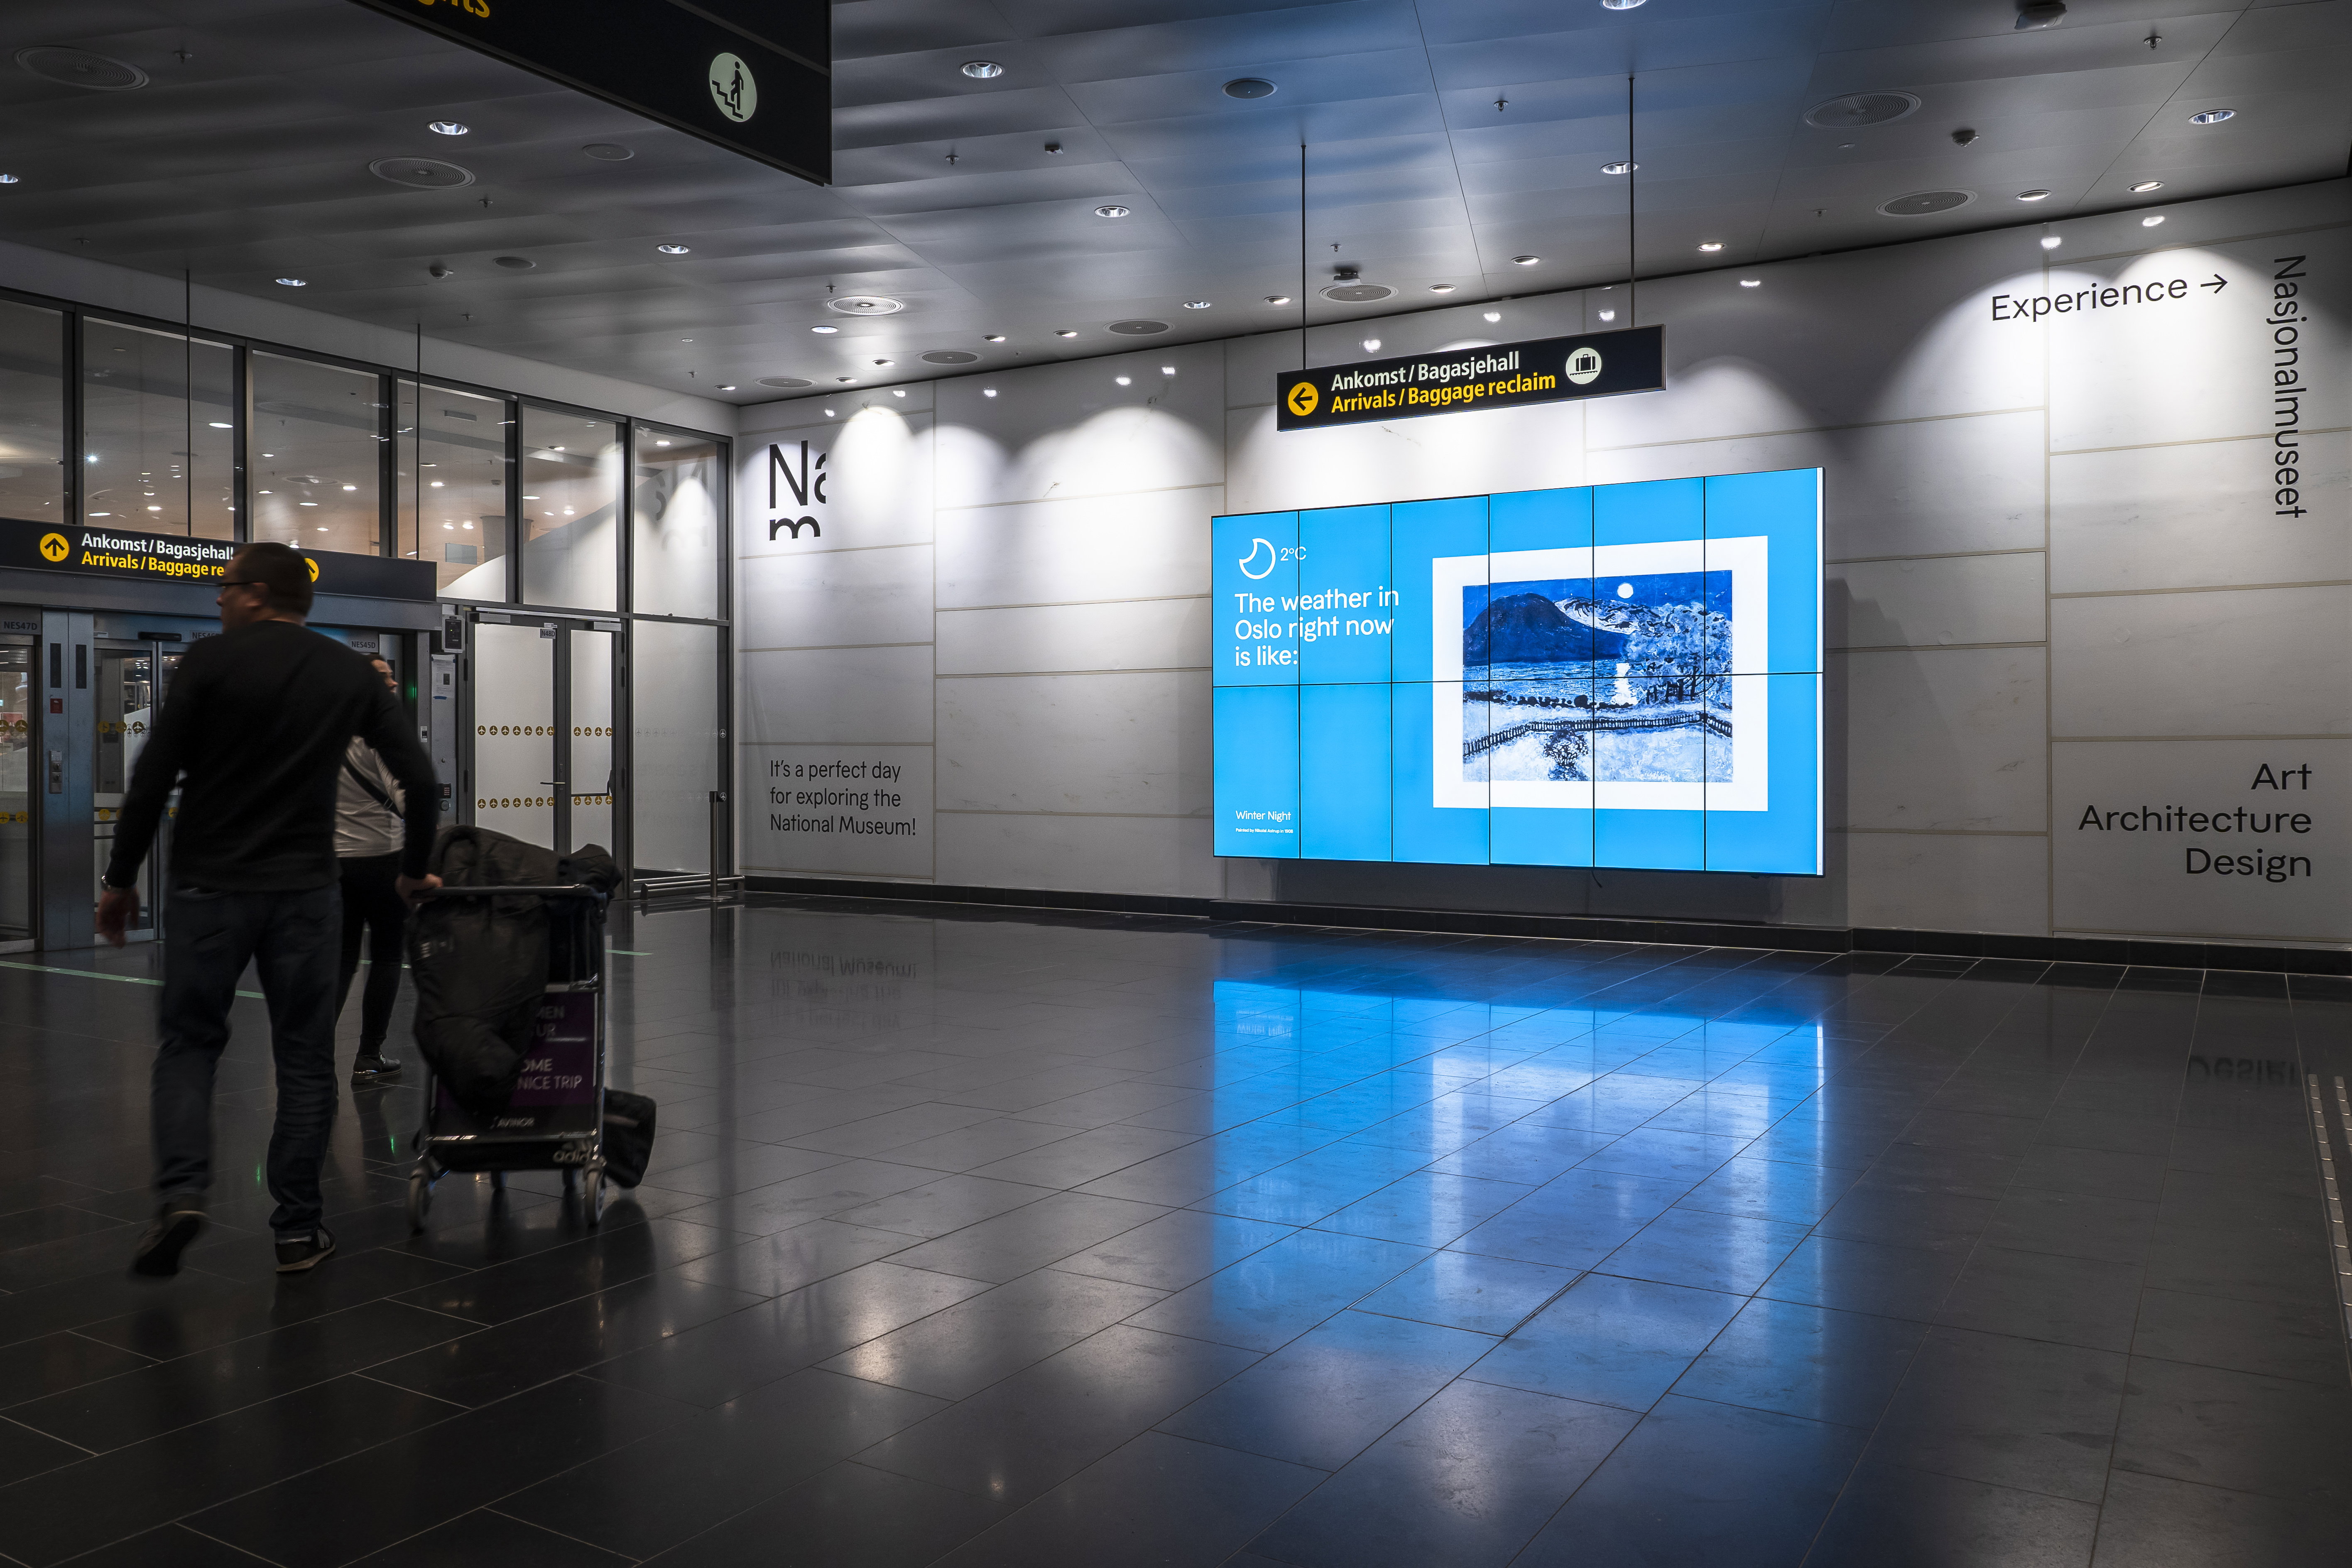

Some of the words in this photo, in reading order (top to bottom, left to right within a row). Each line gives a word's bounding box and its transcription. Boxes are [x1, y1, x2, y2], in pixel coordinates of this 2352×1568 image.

[1992, 278, 2188, 322] Experience
[1331, 368, 1406, 391] Ankomst
[1419, 351, 1519, 382] Bagasjehall
[1331, 390, 1395, 413] Arrivals
[1409, 382, 1484, 406] Baggage
[1489, 372, 1555, 395] reclaim
[2266, 255, 2308, 518] Nasjonalmuseet
[81, 533, 147, 552] Ankomst
[81, 551, 139, 569] Arrivals
[149, 557, 208, 578] Baggage
[1235, 593, 1275, 613] The
[1281, 588, 1372, 611] weather
[1379, 586, 1399, 607] in
[4, 621, 37, 630] NES47D
[1235, 619, 1282, 640] Oslo
[1289, 615, 1339, 642] right
[1346, 618, 1394, 636] now
[351, 641, 376, 649] NES45D
[1235, 646, 1251, 666] is
[1257, 645, 1298, 666] like:
[795, 764, 804, 777] a
[809, 760, 867, 782] perfect
[872, 761, 901, 783] day
[2251, 763, 2312, 790] Art
[770, 787, 791, 804] for
[796, 788, 869, 811] exploring
[874, 789, 901, 807] the
[770, 813, 833, 833] National
[839, 816, 916, 836] Museum!
[1235, 810, 1266, 820] Winter
[1268, 811, 1291, 822] Night
[2078, 805, 2312, 833] Architecture
[2186, 848, 2311, 883] Design
[554, 1075, 582, 1089] TRIP
